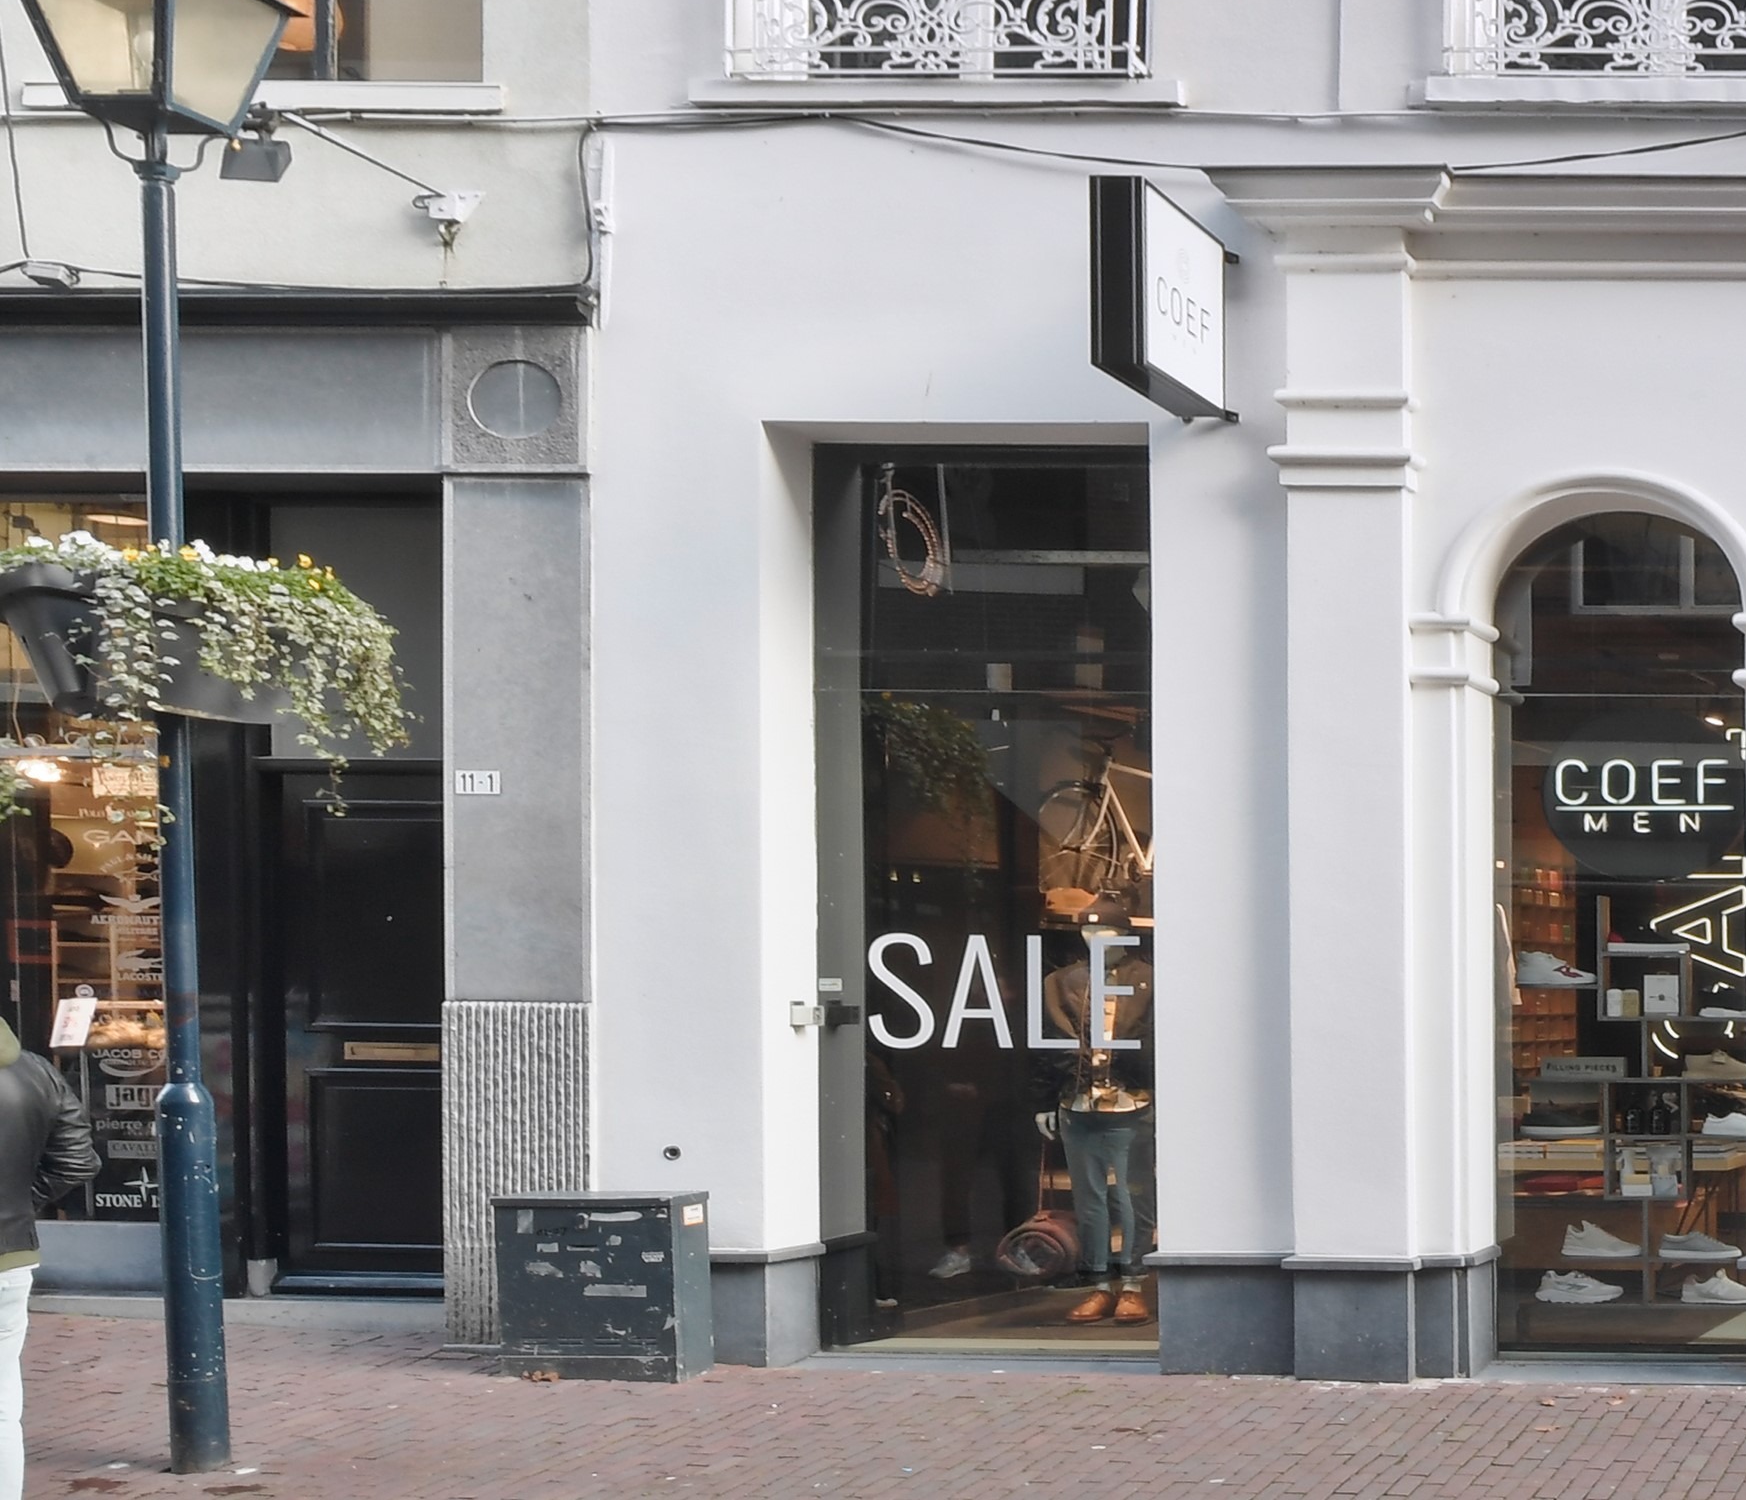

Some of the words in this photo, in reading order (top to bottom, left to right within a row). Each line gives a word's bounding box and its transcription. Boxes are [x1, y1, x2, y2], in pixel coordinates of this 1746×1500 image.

[1156, 275, 1212, 344] COEF
[1555, 758, 1729, 805] COEF
[1583, 811, 1702, 833] MEN
[867, 932, 1142, 1050] SALE
[92, 1049, 142, 1059] JACOB
[95, 1117, 142, 1132] pierre
[95, 1193, 143, 1208] STONE
